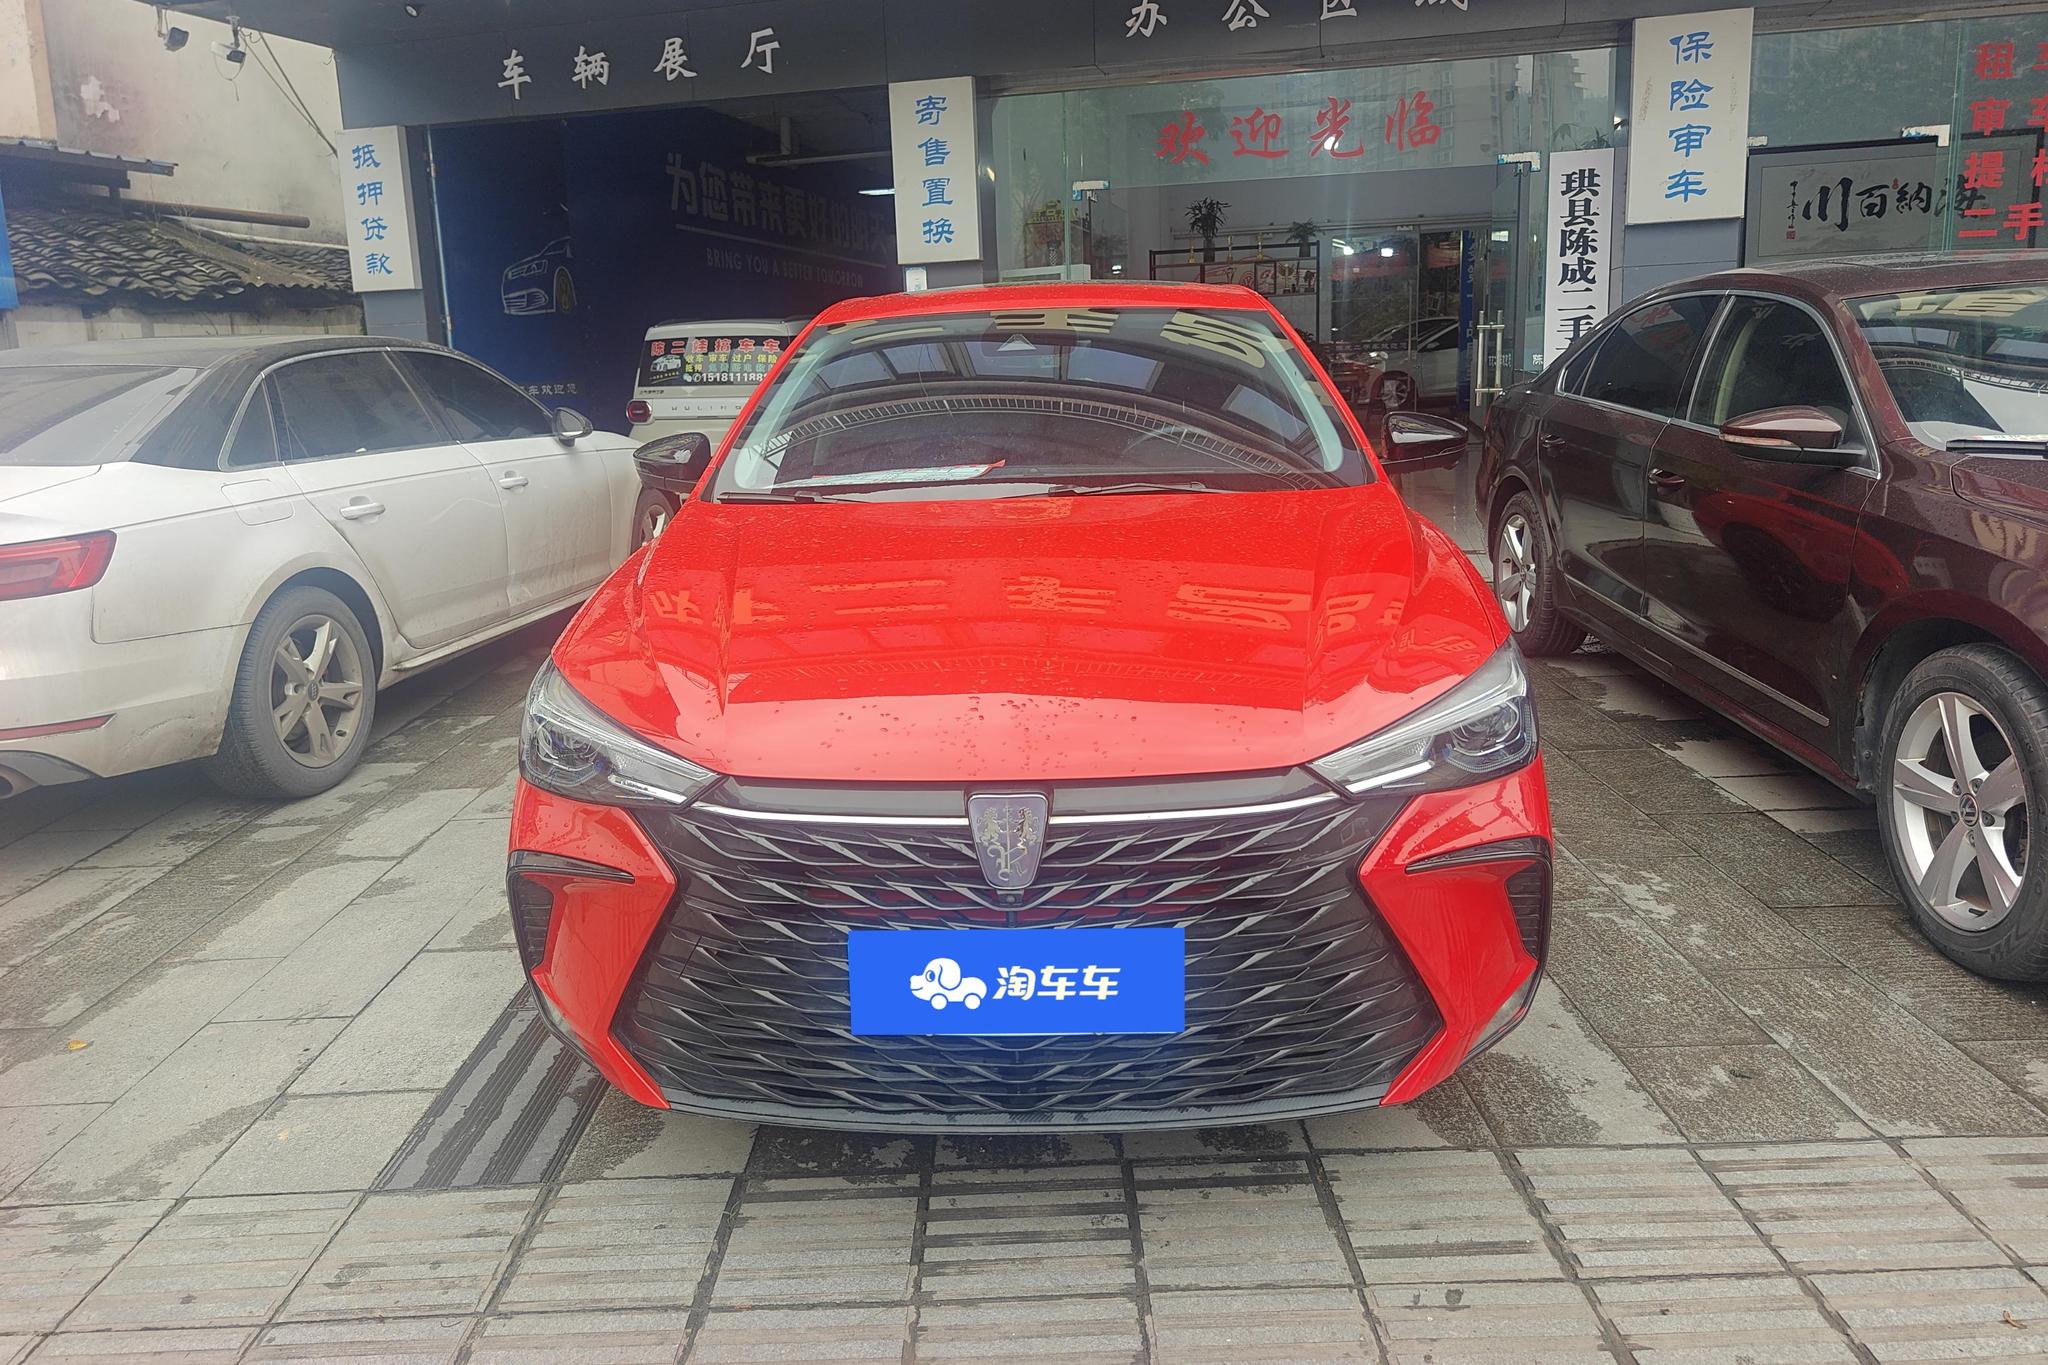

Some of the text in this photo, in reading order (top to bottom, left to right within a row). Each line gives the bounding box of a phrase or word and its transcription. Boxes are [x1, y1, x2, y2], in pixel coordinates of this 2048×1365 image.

[497, 26, 782, 100] 车辆展厅
[1125, 0, 1469, 38] 办公区
[1153, 90, 1442, 167] 欢迎光临
[1664, 30, 1714, 203] 保险审车
[351, 144, 394, 276] 抵押贷款
[914, 94, 955, 246] 寄售置换
[706, 247, 742, 270] BRING
[745, 253, 769, 276] YOU
[772, 262, 780, 276] A
[1555, 167, 1601, 351] 珙县陈成二手
